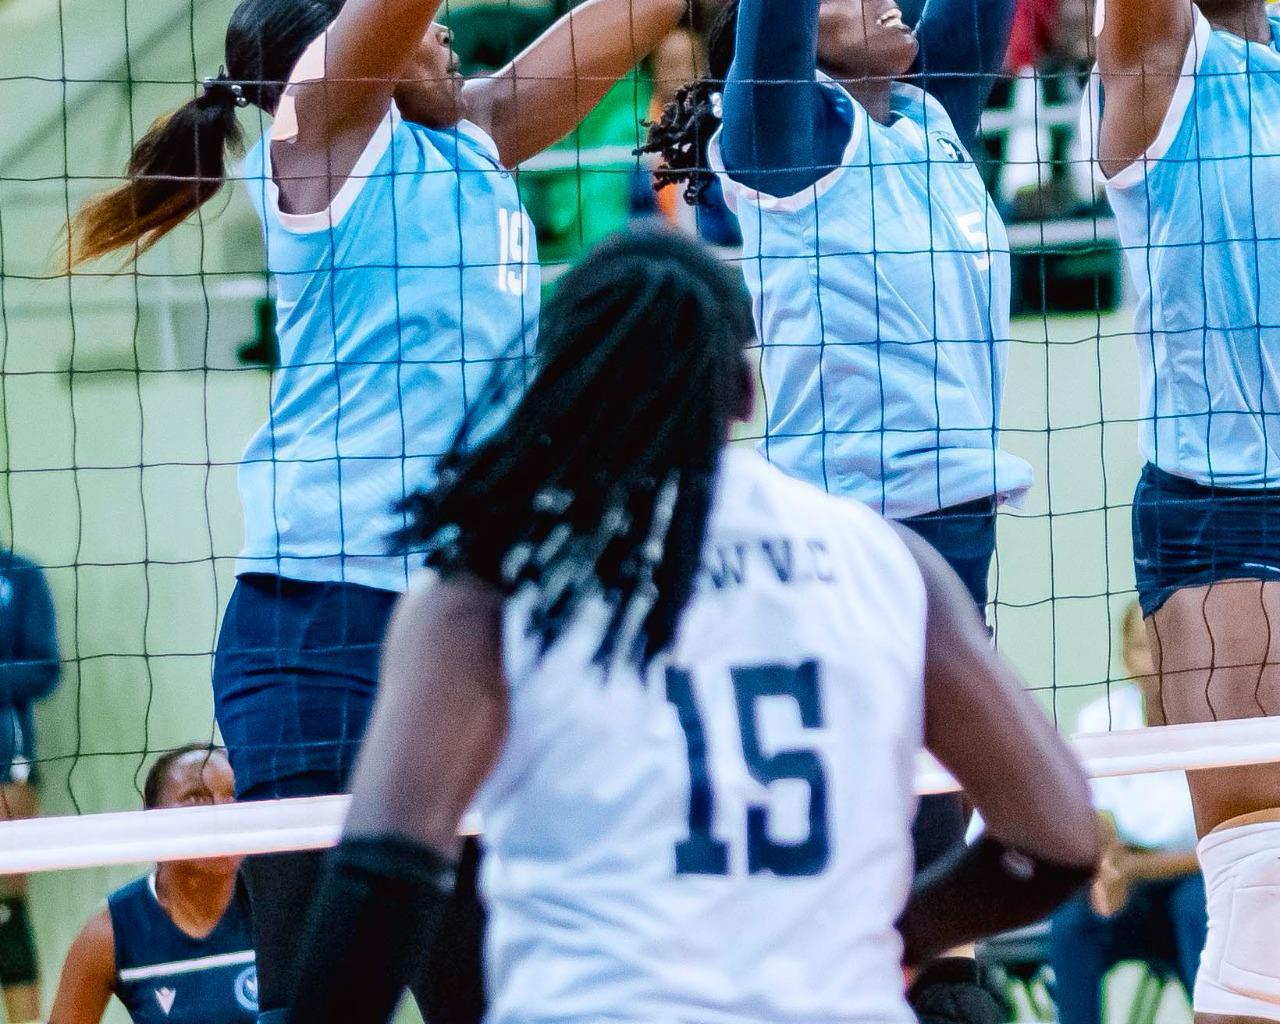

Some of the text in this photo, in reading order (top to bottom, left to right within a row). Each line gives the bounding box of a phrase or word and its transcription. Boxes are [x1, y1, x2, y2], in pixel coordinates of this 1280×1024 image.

[498, 207, 530, 296] 19
[957, 211, 994, 271] 5
[665, 660, 832, 876] 15
